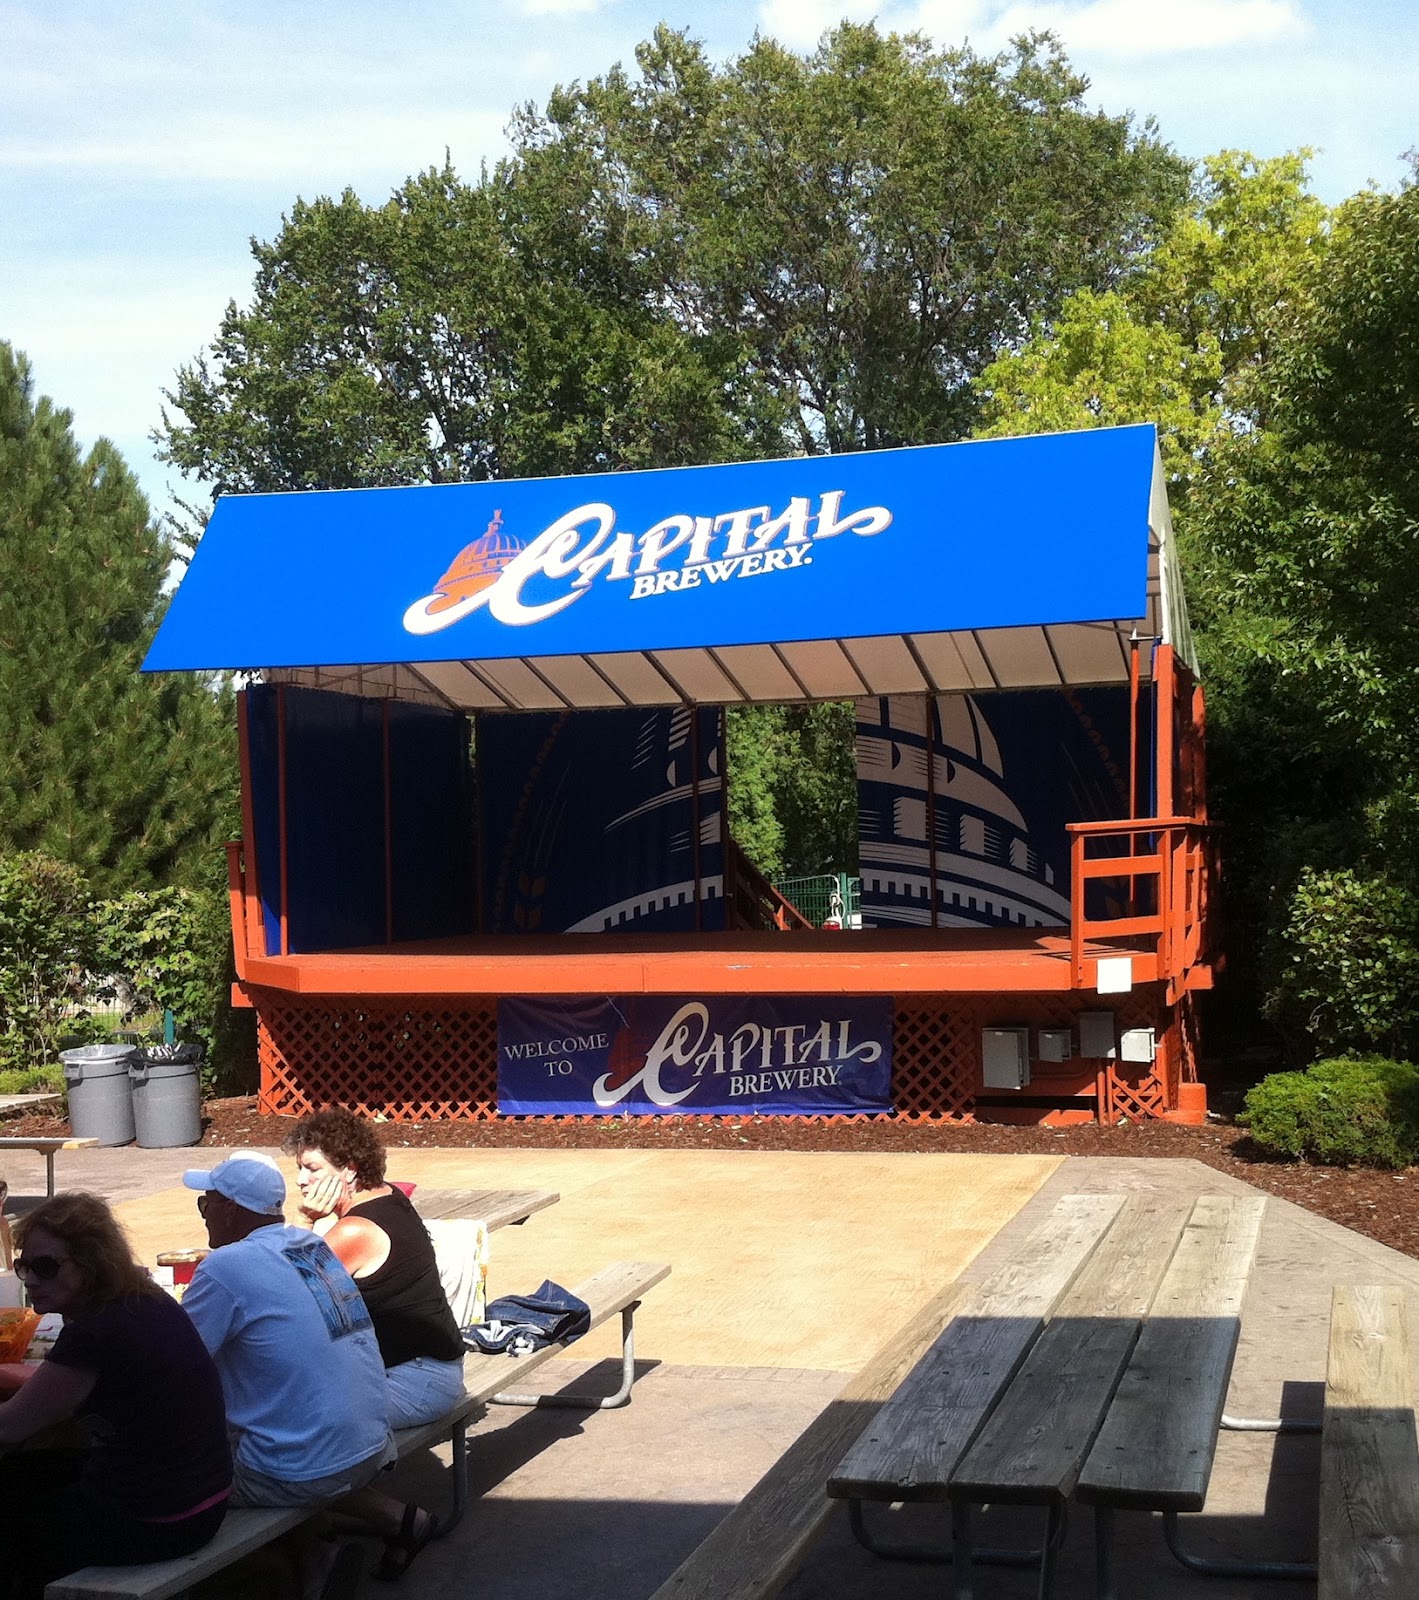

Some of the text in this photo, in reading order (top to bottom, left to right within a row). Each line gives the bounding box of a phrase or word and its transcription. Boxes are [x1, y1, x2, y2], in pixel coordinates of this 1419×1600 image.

[403, 490, 893, 634] CAPITAL
[503, 1033, 609, 1060] WELCOME
[543, 1060, 573, 1076] TO
[593, 1002, 882, 1106] CAPITAL
